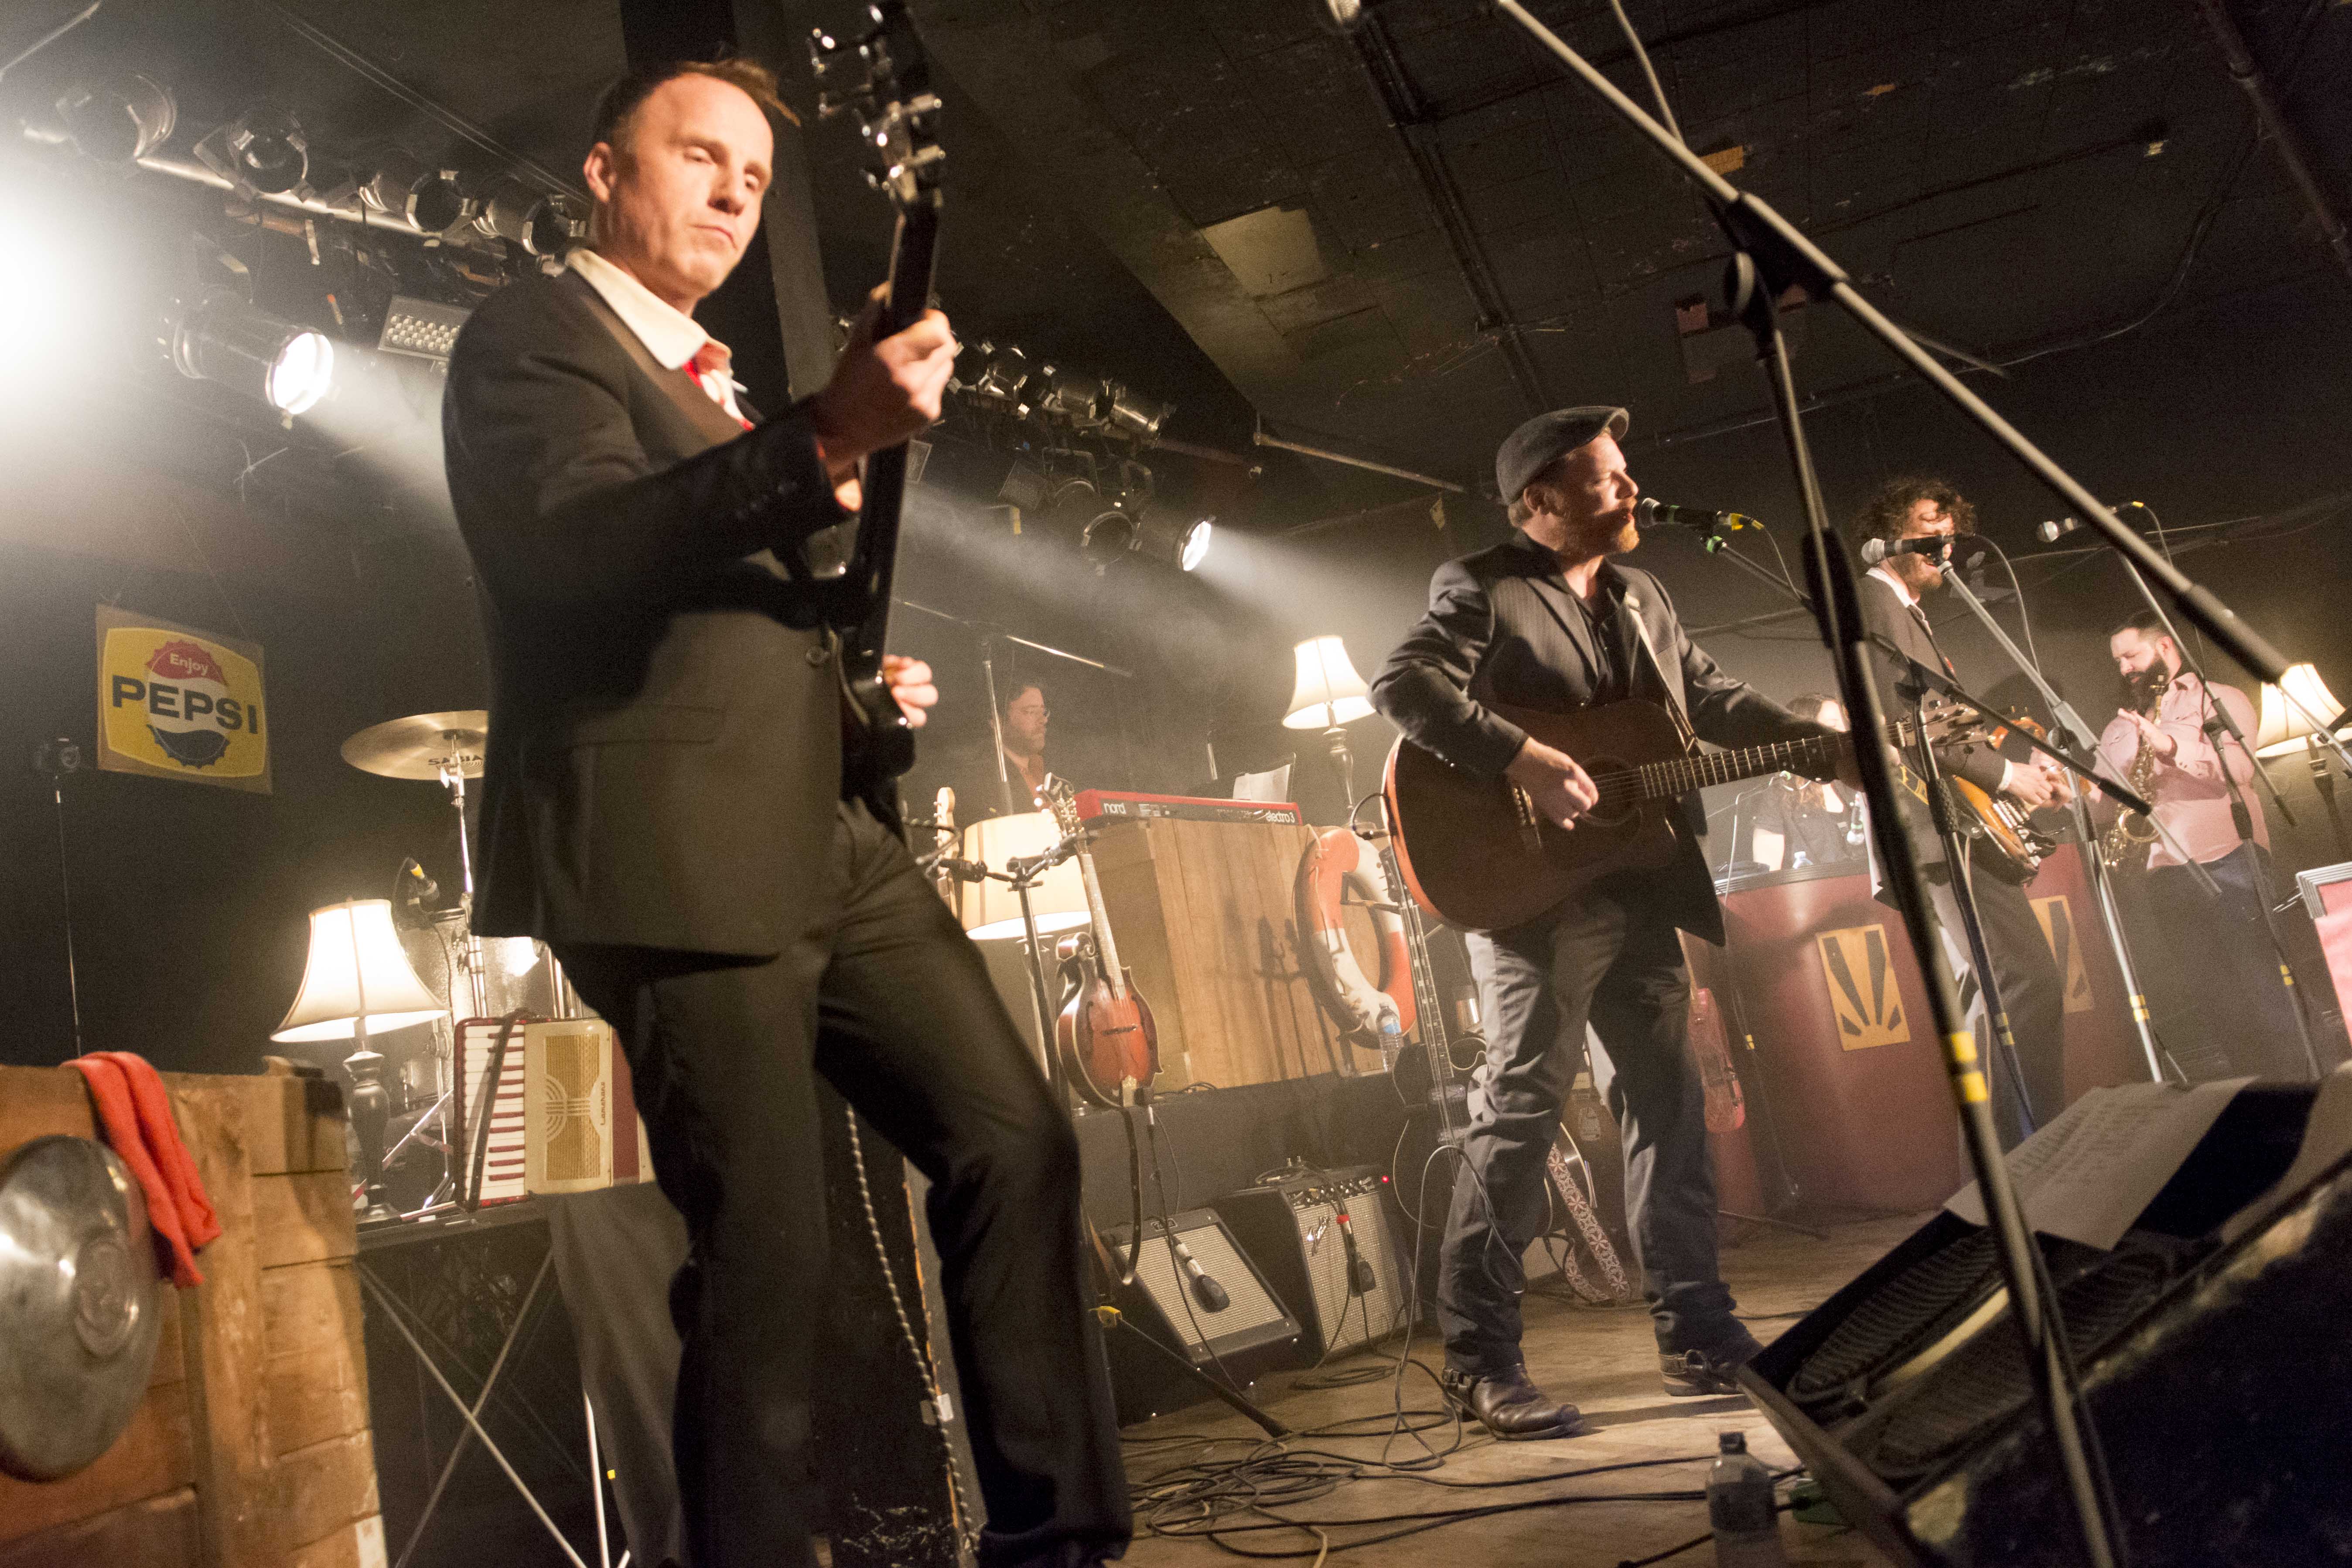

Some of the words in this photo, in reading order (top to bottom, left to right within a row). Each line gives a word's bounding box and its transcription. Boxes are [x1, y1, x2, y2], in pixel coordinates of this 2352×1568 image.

[169, 652, 208, 677] Enjoy
[112, 674, 258, 734] PEPSI
[1103, 802, 1127, 815] nord
